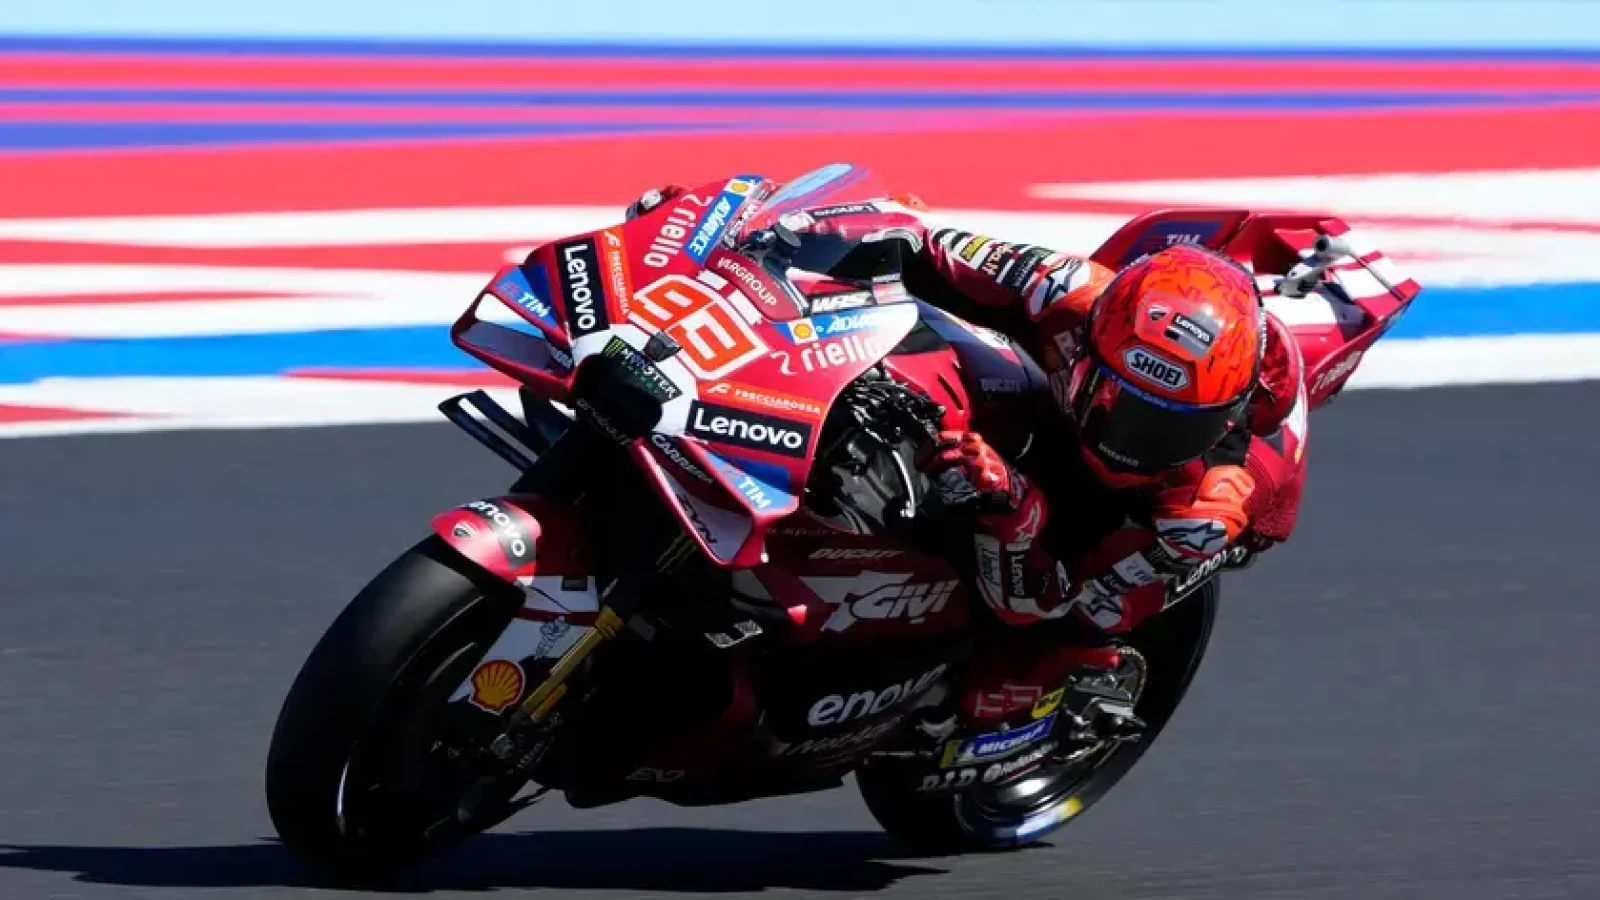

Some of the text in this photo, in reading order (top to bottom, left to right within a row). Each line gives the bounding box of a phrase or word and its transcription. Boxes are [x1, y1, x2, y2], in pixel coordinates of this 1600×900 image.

[644, 206, 697, 267] riello
[518, 291, 552, 318] TIM
[563, 243, 596, 330] Lenovo
[627, 277, 763, 377] 93
[1175, 315, 1211, 343] Lenovo
[1132, 352, 1182, 386] SHOEI
[693, 407, 803, 449] Lenovo
[738, 475, 772, 510] TIM
